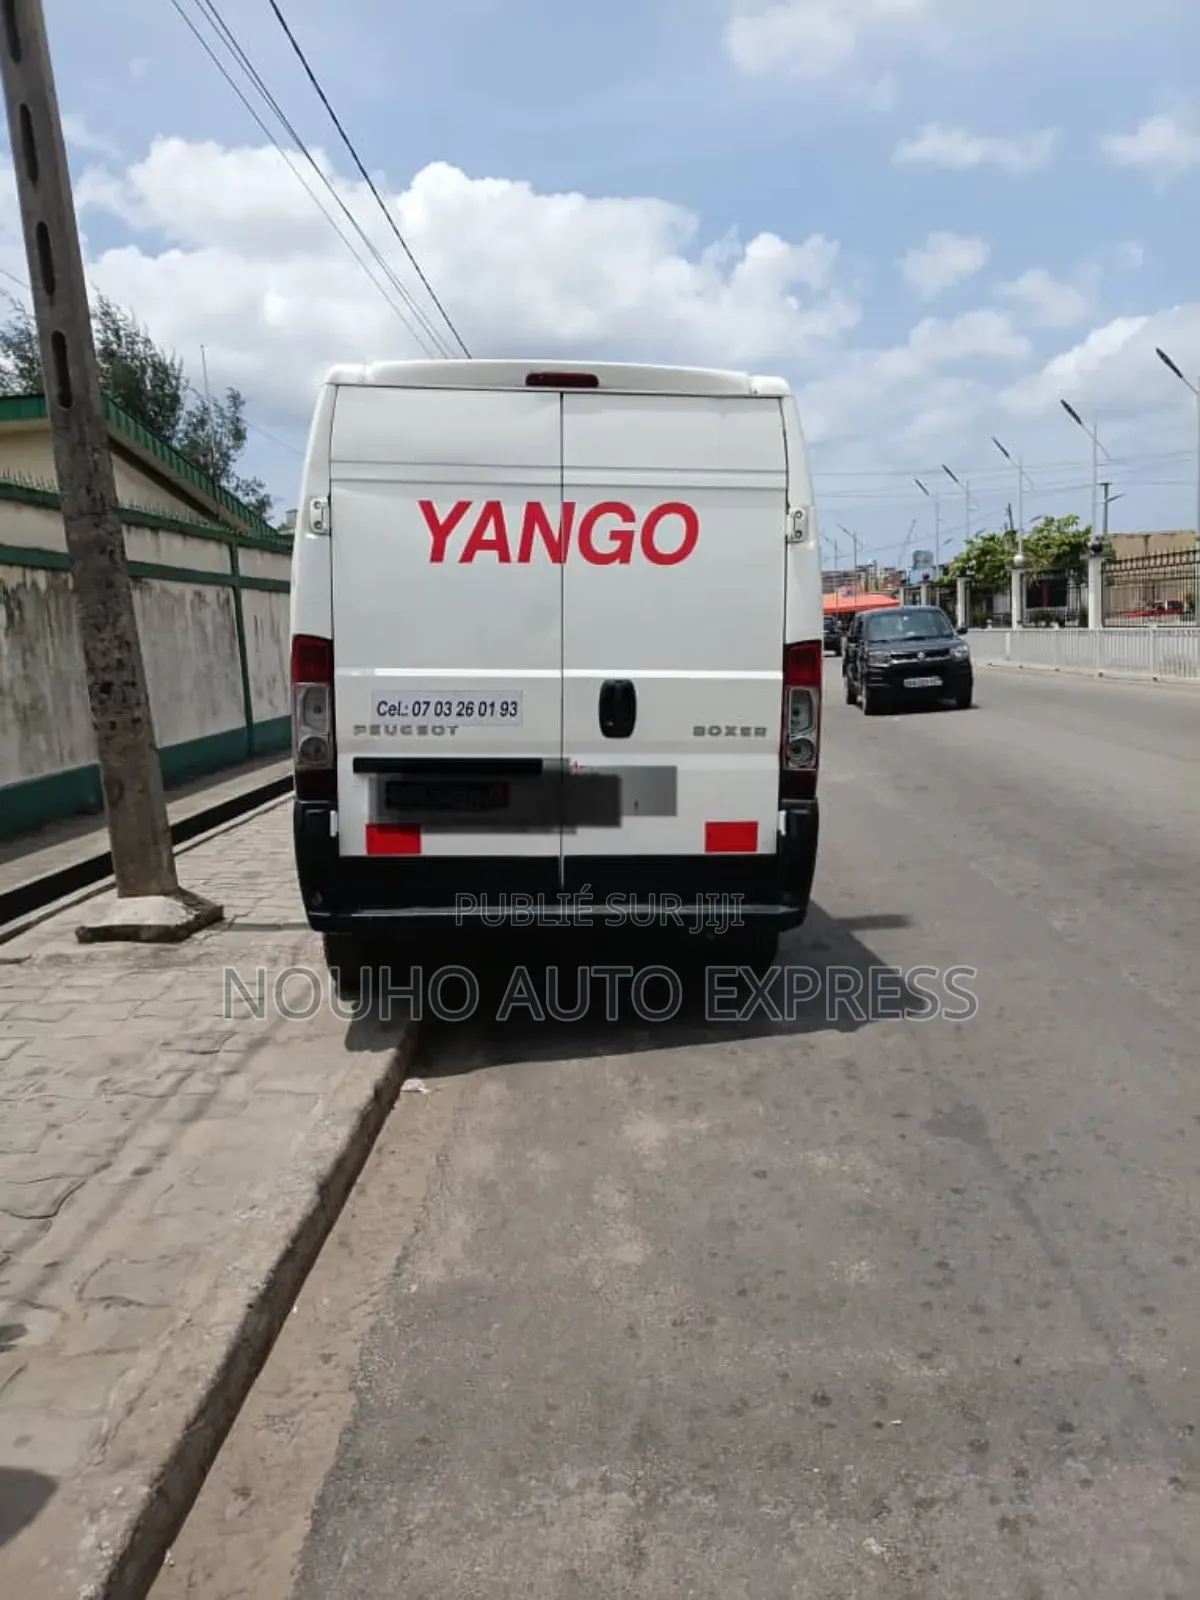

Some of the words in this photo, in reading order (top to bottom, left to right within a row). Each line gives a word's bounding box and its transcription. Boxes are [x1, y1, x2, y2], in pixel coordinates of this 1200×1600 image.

[418, 500, 700, 566] YANGO
[412, 700, 430, 717] 07
[434, 700, 452, 717] 03
[456, 700, 474, 717] 26
[478, 700, 495, 717] 01
[499, 700, 518, 717] 93
[353, 724, 459, 737] PEUGEOT
[692, 725, 767, 738] BOXER
